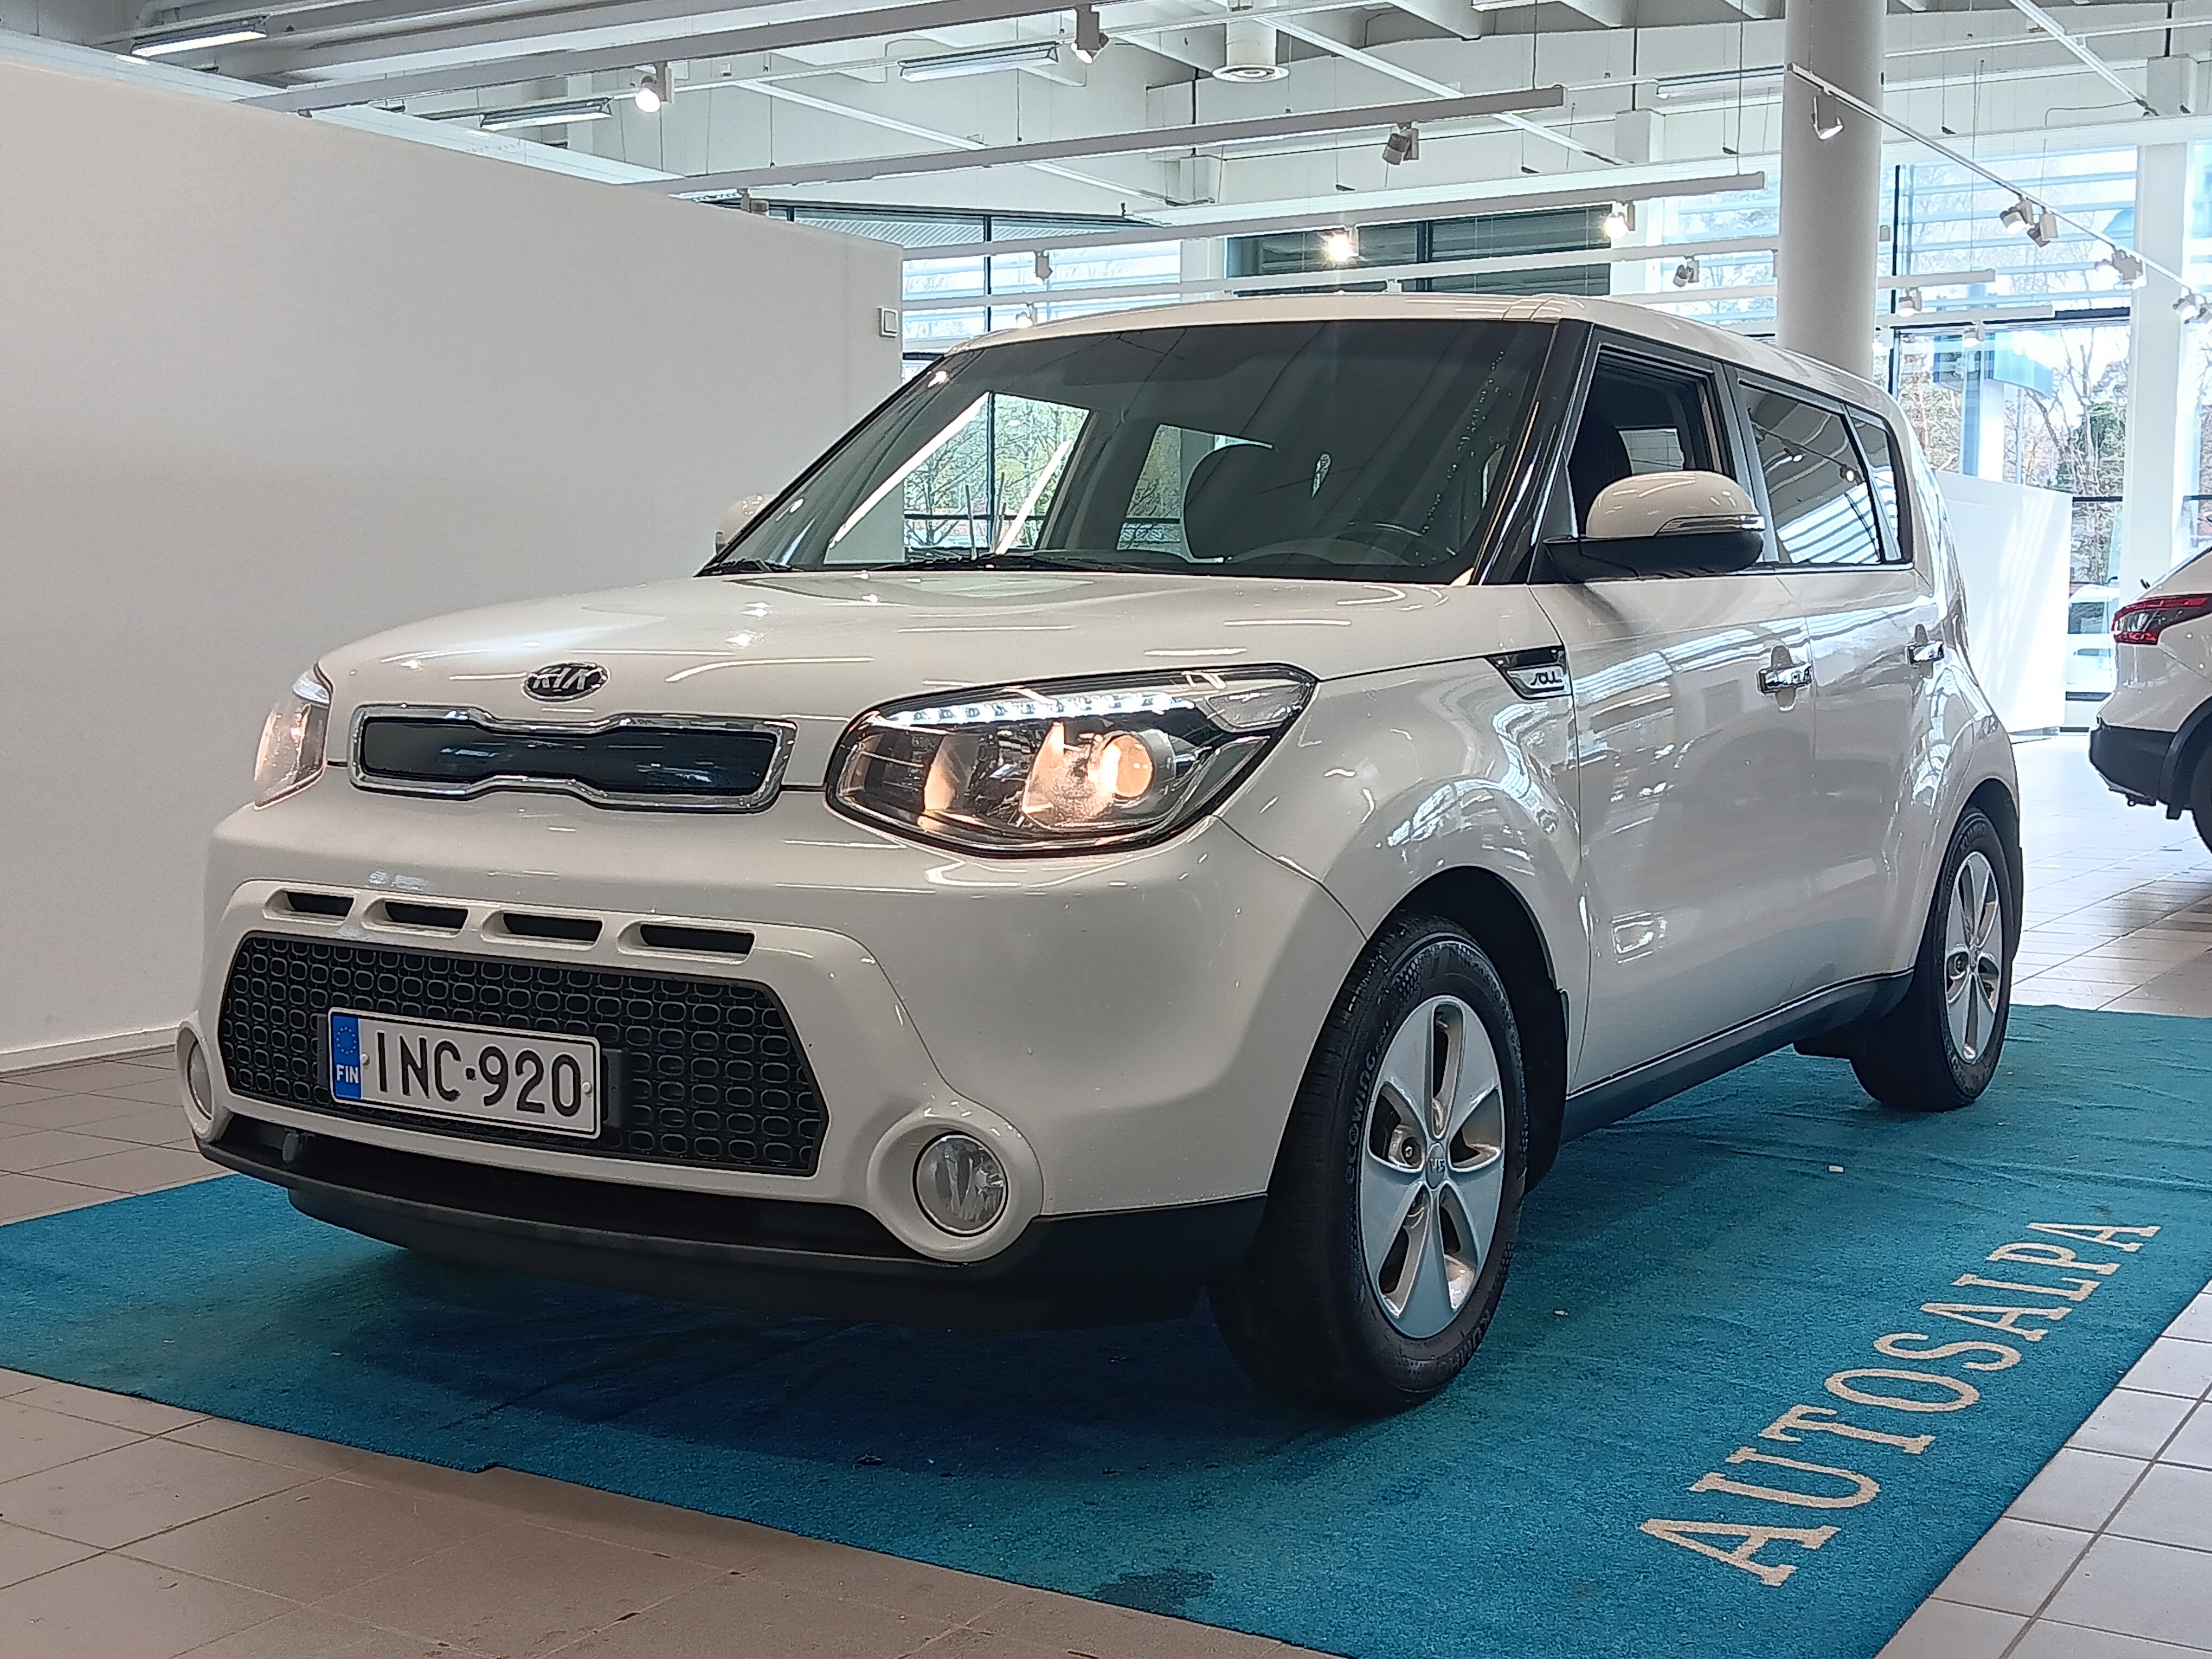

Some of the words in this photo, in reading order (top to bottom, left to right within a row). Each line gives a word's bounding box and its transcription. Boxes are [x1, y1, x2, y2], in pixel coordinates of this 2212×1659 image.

[532, 667, 589, 690] KIA
[336, 1064, 359, 1084] FIN
[1638, 1221, 2162, 1587] AUTOSALPA
